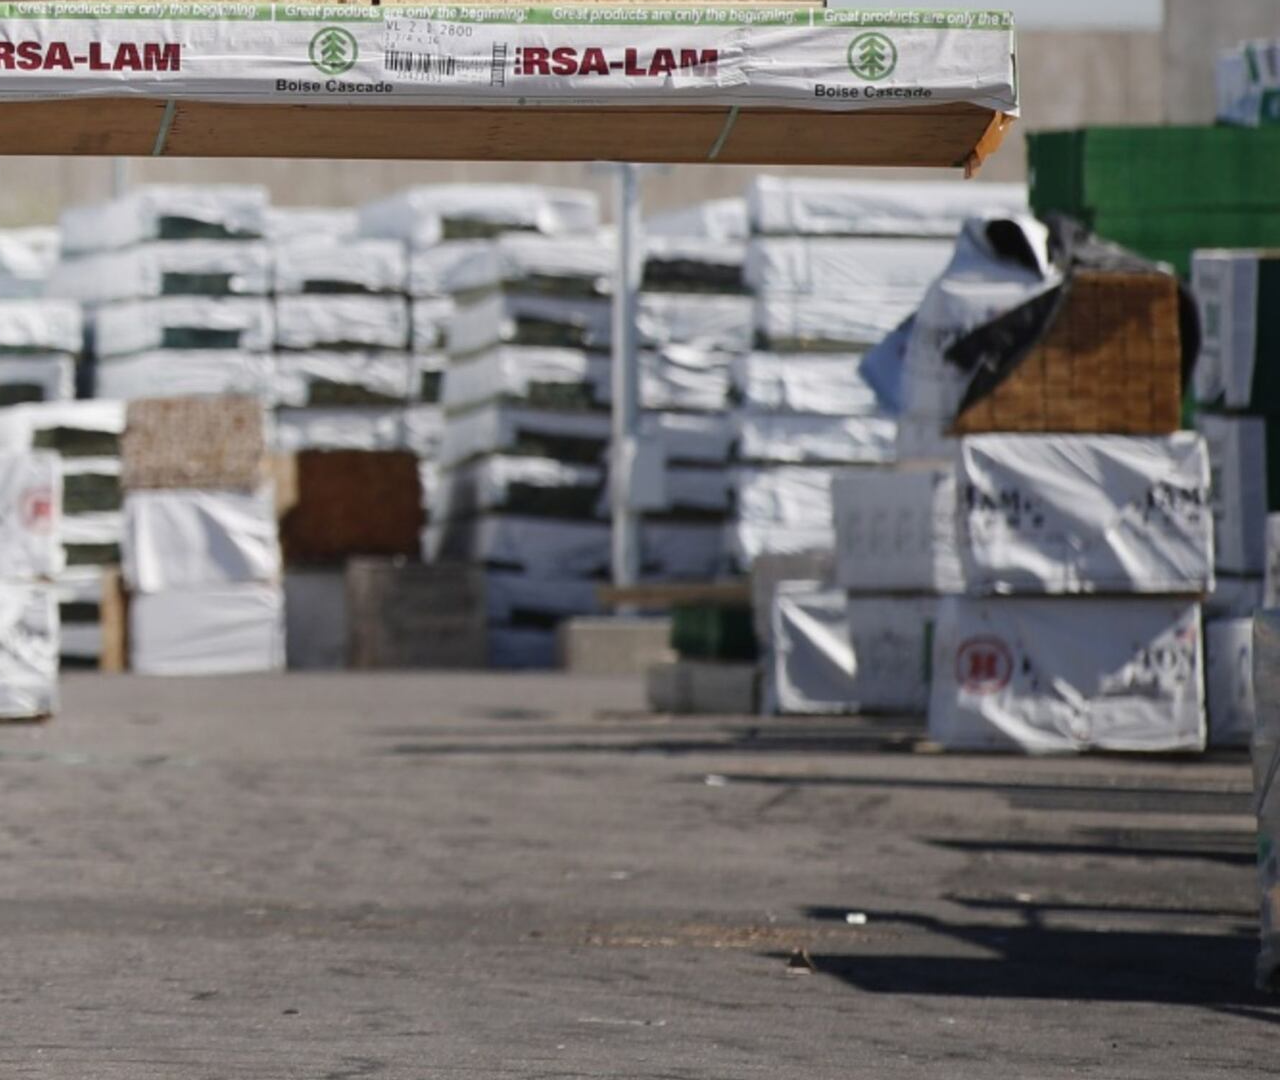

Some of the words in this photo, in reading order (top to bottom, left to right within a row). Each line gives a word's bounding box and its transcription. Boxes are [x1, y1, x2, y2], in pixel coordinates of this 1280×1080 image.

[17, 3, 52, 14] Great
[53, 3, 111, 18] products
[116, 5, 135, 14] are
[139, 3, 167, 18] only
[169, 3, 189, 15] the
[285, 5, 320, 17] Great
[321, 5, 379, 21] products
[383, 8, 403, 17] are
[406, 6, 434, 20] only
[437, 5, 457, 18] the
[552, 8, 589, 20] Great
[589, 8, 648, 24] products
[652, 10, 672, 20] are
[675, 9, 702, 24] only
[705, 8, 727, 20] the
[824, 9, 859, 21] Great
[860, 9, 920, 25] products
[923, 12, 944, 23] are
[947, 11, 976, 27] only
[979, 12, 1000, 25] the
[386, 20, 400, 31] VL
[440, 24, 473, 37] 2800
[514, 47, 718, 76] RSA-LAM
[276, 78, 320, 91] Boise
[325, 80, 393, 93] Cascade
[814, 84, 859, 98] Boise
[864, 86, 932, 98] Cascade
